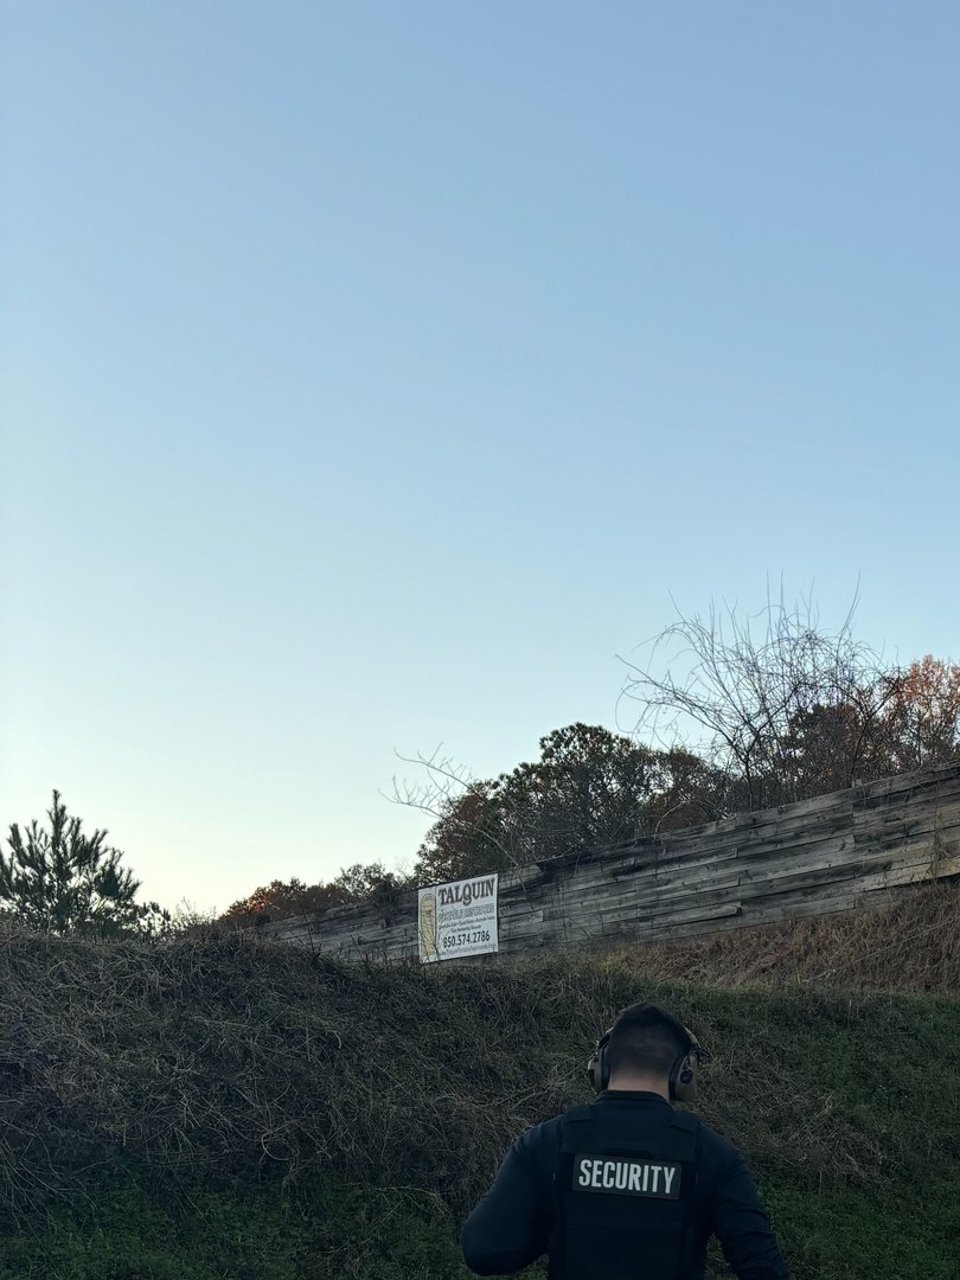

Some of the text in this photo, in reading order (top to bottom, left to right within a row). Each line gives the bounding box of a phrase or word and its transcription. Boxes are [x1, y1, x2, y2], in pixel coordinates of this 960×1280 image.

[438, 878, 495, 906] TALQUIN
[442, 930, 490, 948] 850.574.2786
[578, 1159, 676, 1194] SECURITY
